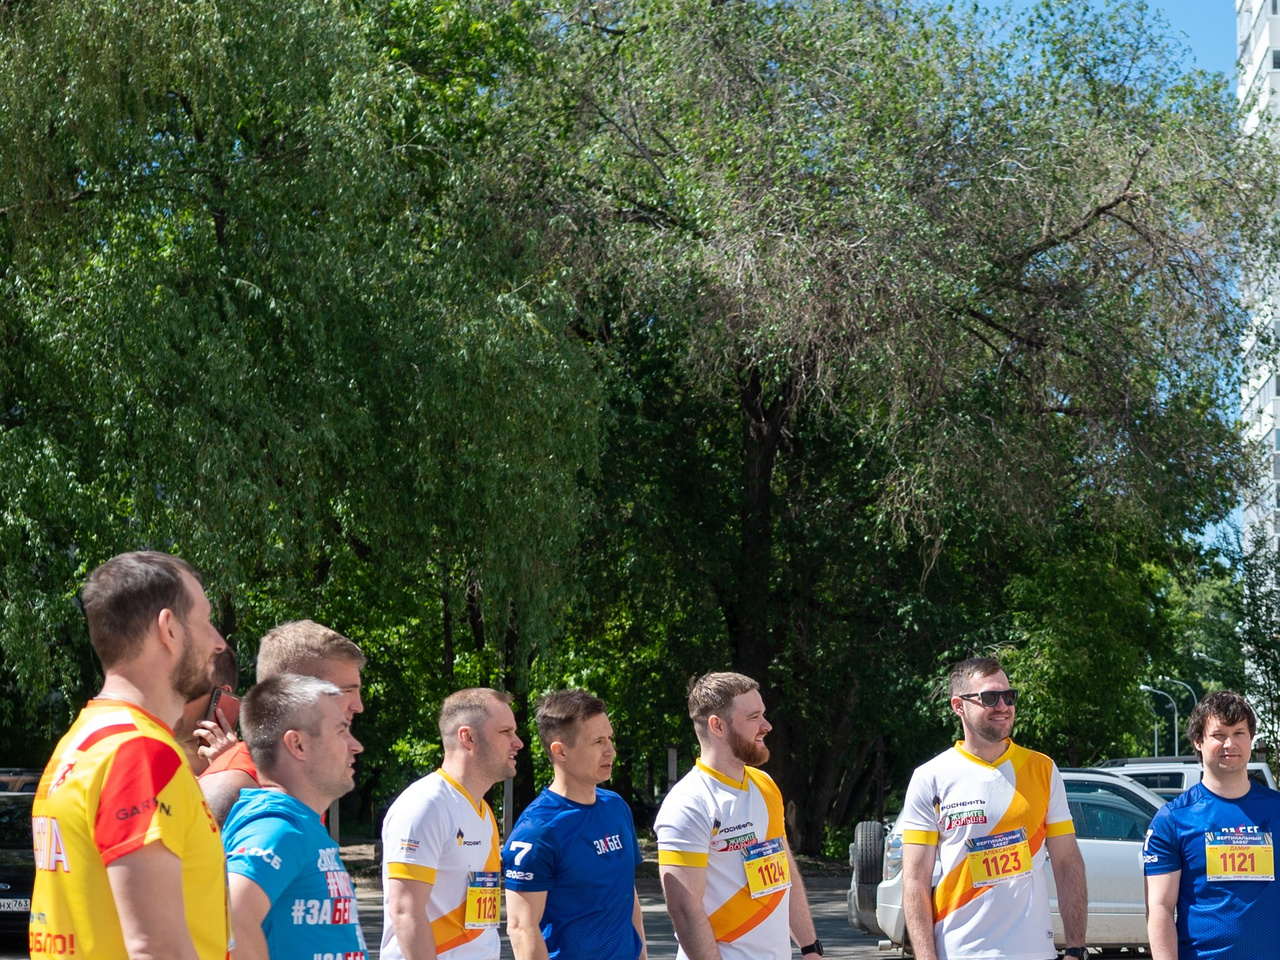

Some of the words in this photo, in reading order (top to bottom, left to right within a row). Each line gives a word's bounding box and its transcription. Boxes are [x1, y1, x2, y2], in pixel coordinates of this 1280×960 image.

[509, 841, 533, 866] 7
[982, 851, 1022, 877] 1123
[1143, 855, 1158, 863] 23
[1220, 852, 1255, 872] 1121
[505, 869, 534, 880] 2023
[758, 861, 786, 886] 1124
[13, 900, 29, 908] 763
[477, 896, 497, 919] 1126
